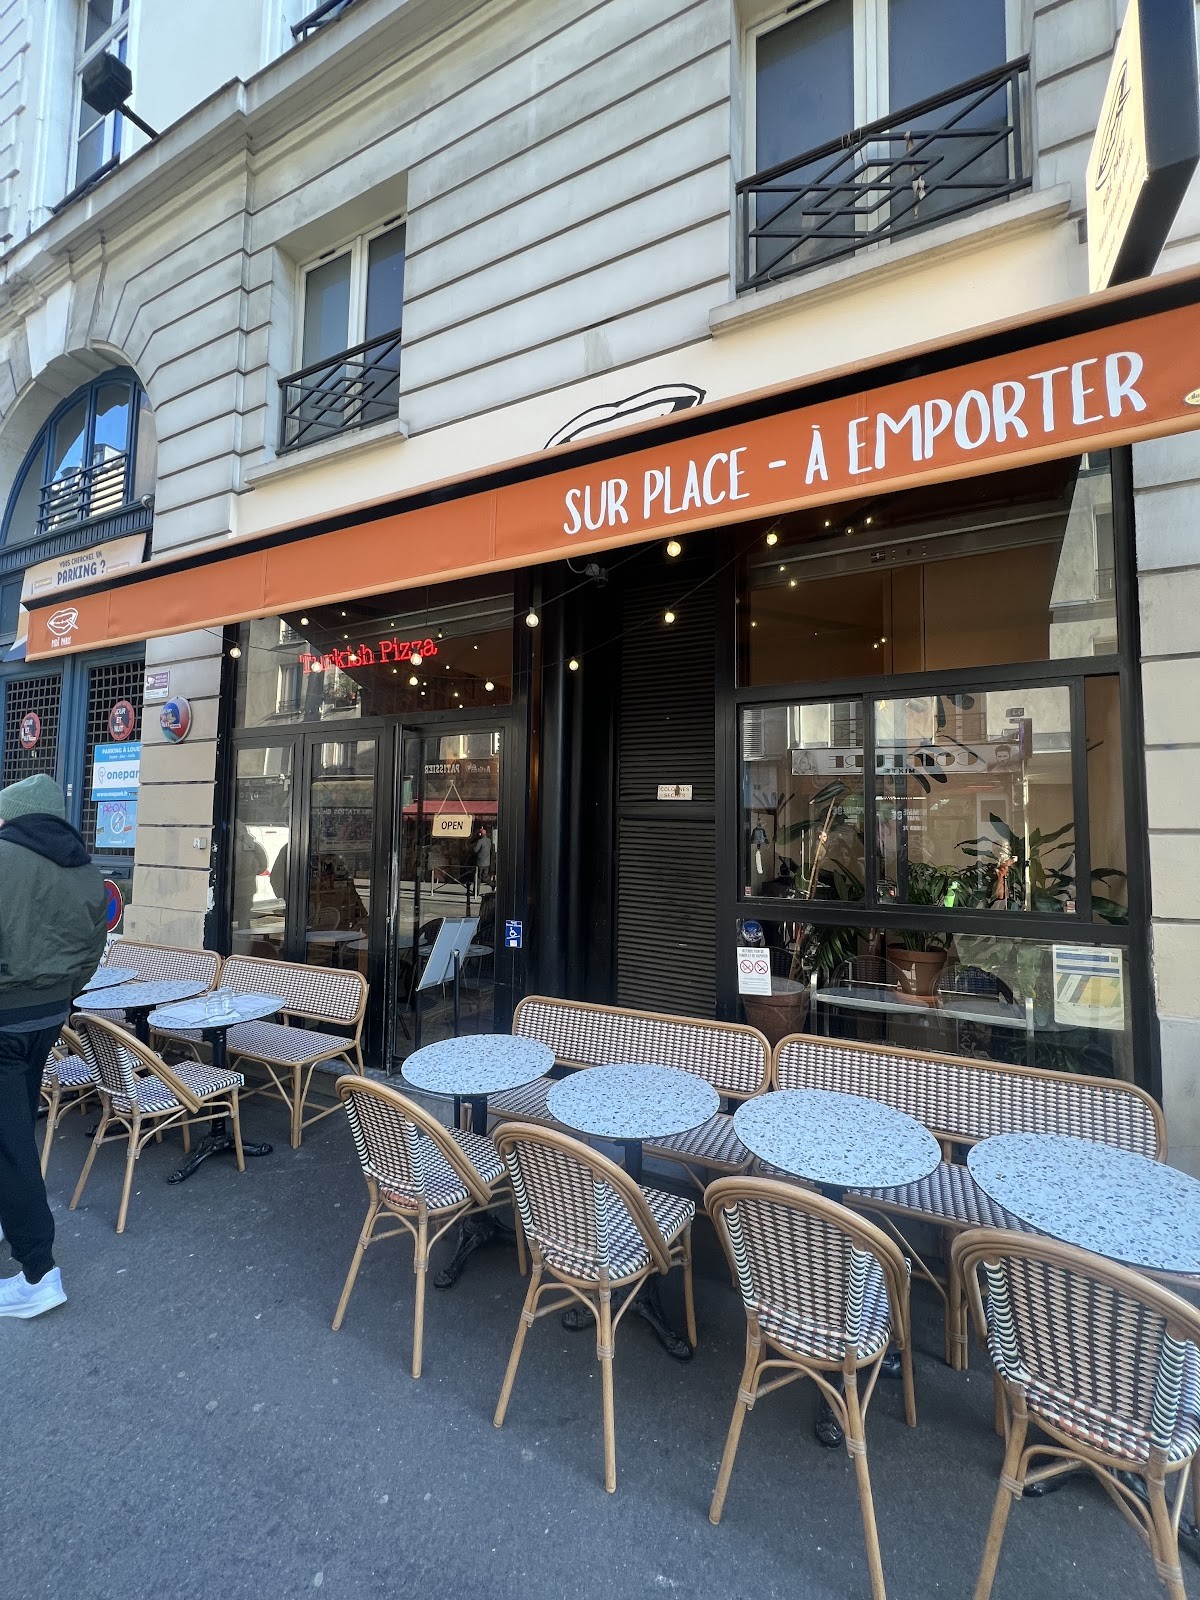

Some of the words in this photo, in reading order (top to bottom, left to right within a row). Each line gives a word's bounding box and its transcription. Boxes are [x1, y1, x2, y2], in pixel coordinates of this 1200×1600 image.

[563, 477, 630, 536] SUR
[643, 446, 751, 519] PLACE
[767, 459, 788, 470] -
[804, 423, 829, 486] À
[848, 350, 1148, 477] EMPORTER
[57, 561, 97, 585] PARKING
[100, 559, 106, 574] ?
[298, 643, 376, 675] Turkish
[378, 637, 438, 663] Pizza
[114, 707, 126, 716] JOUR
[116, 716, 122, 724] ET
[113, 724, 124, 733] NUIT
[101, 747, 122, 755] PARKING
[127, 745, 141, 753] LOUE
[107, 768, 140, 781] onepar
[441, 820, 464, 830] OPEN
